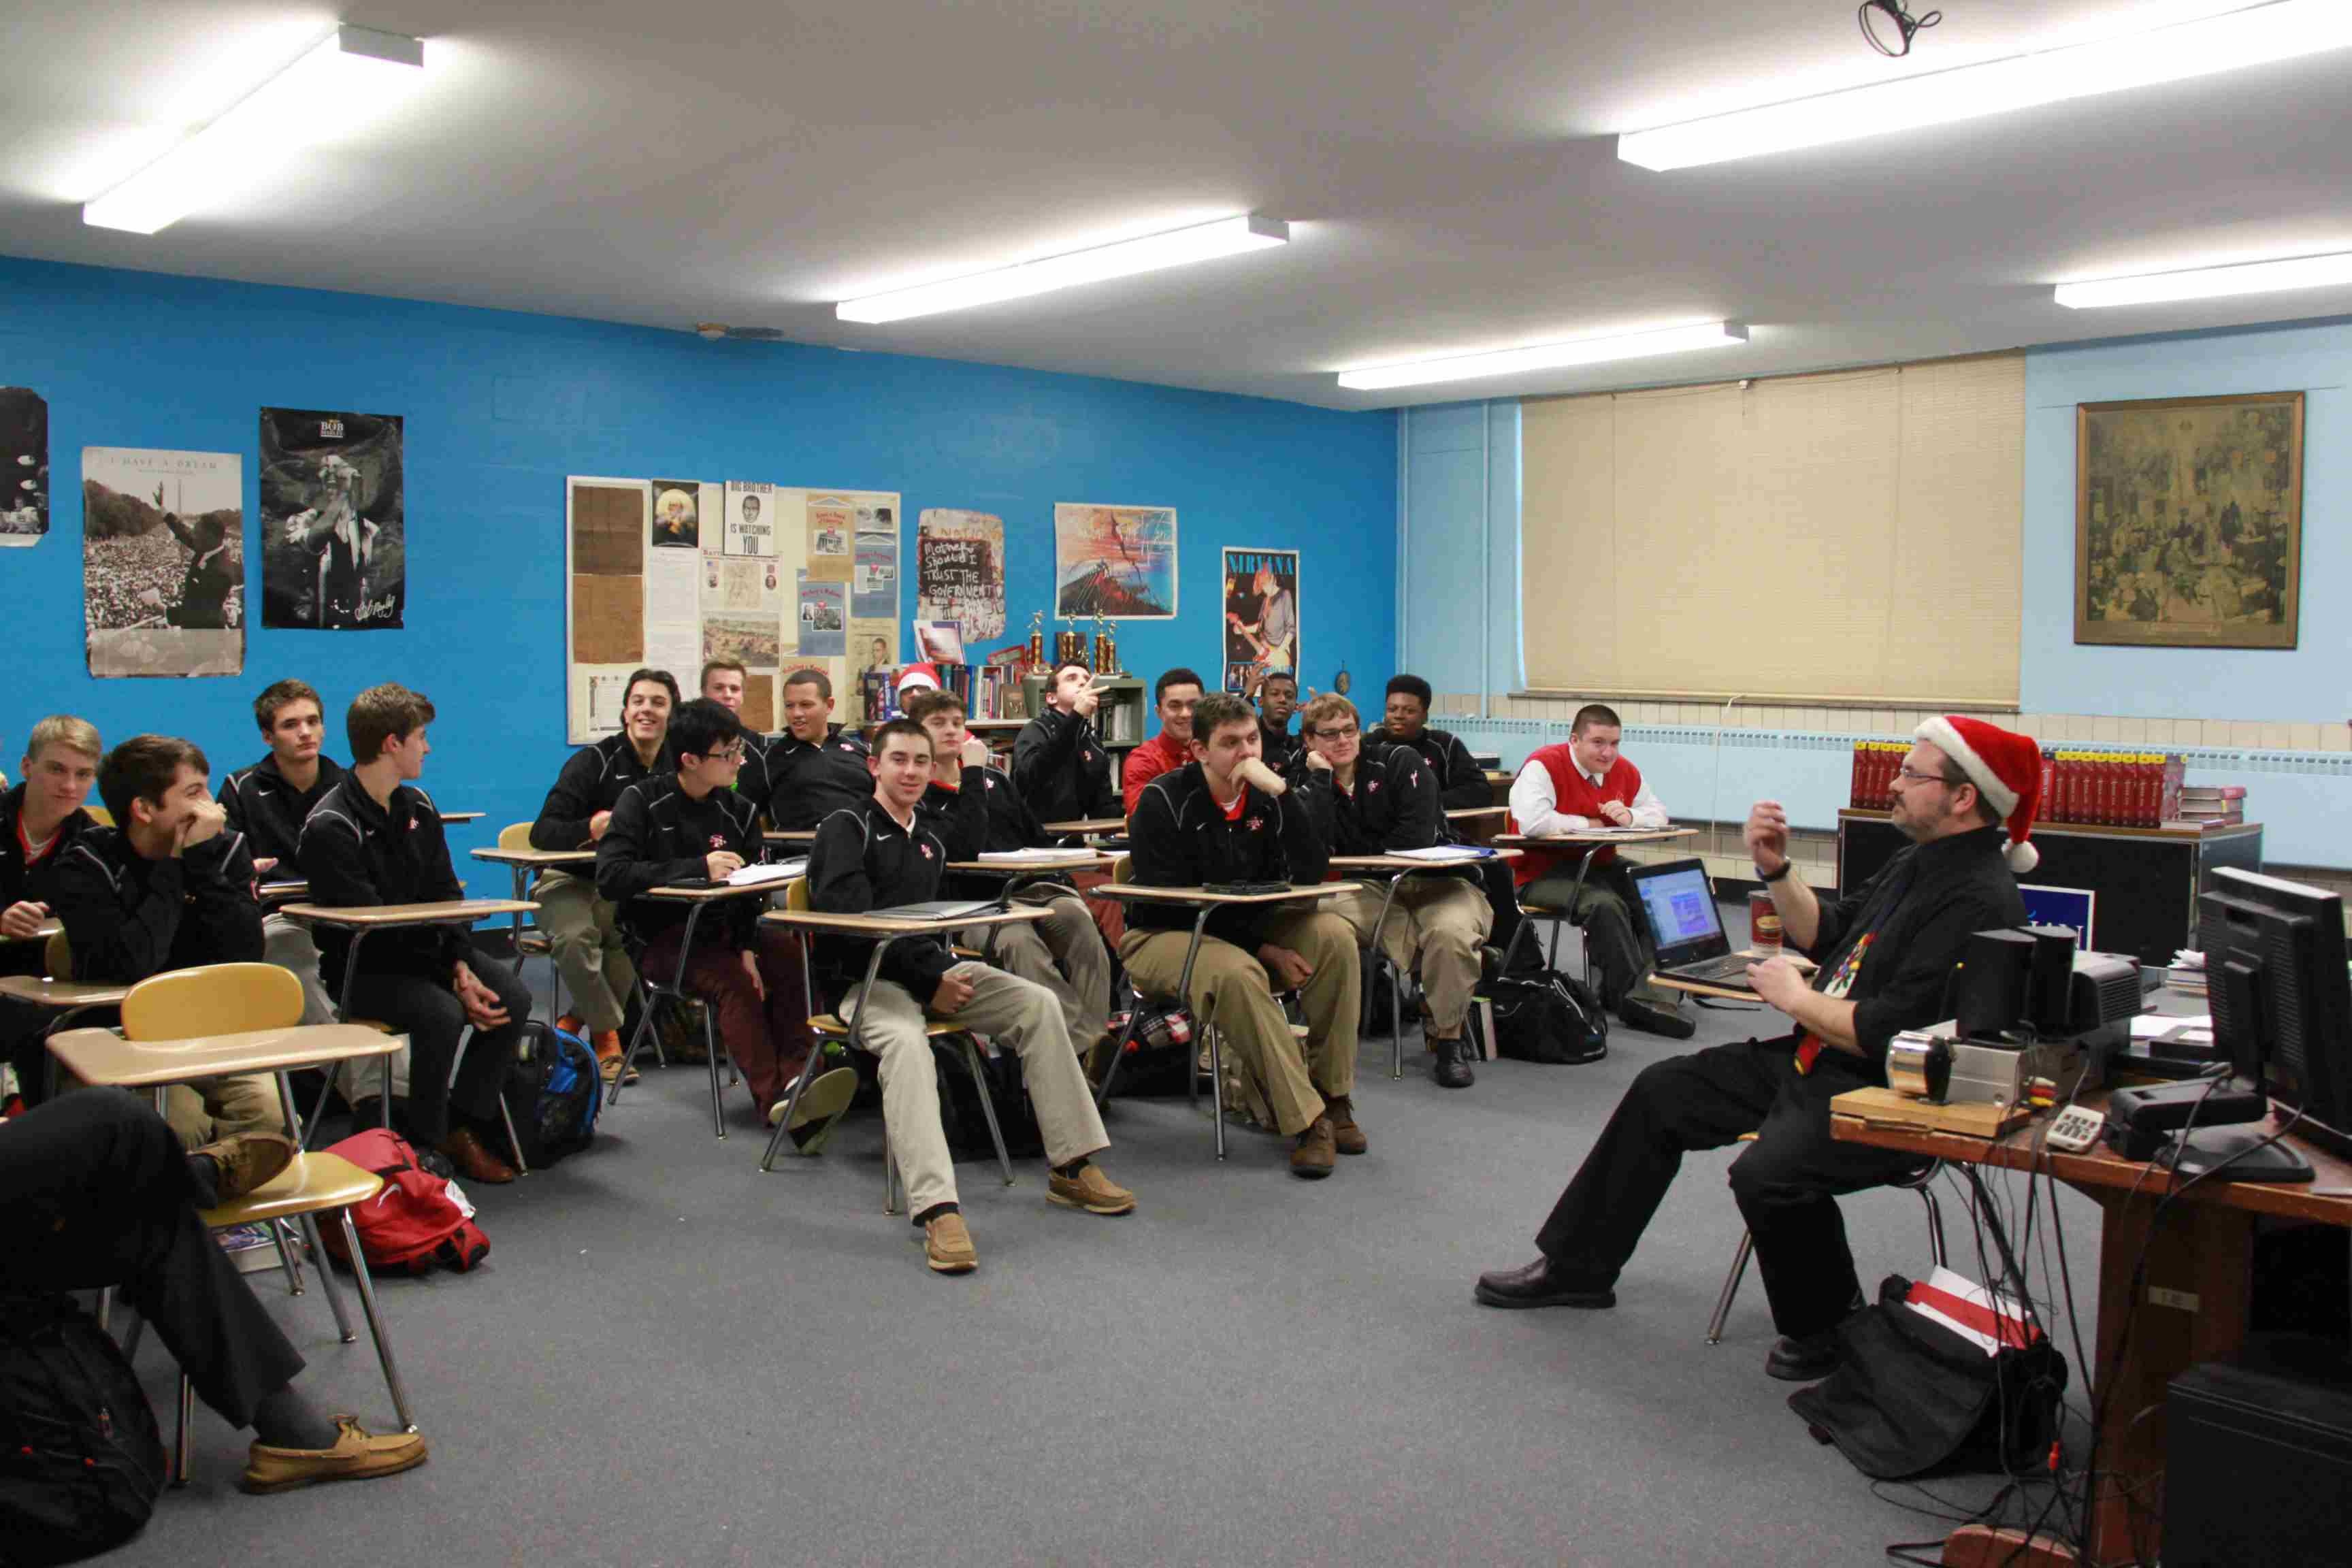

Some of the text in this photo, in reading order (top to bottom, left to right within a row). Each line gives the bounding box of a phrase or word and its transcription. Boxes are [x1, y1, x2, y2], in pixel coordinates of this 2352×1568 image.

[321, 421, 344, 431] BOB
[122, 457, 153, 467] HAVE
[176, 459, 217, 470] DREAM
[742, 481, 773, 495] BROTHER
[730, 522, 771, 536] IS WATCHING
[743, 535, 759, 555] YOU
[968, 555, 978, 566] I
[1226, 553, 1294, 575] NIRVANA
[923, 568, 980, 584] TRUST THE
[928, 583, 993, 600] GOVERNMENT
